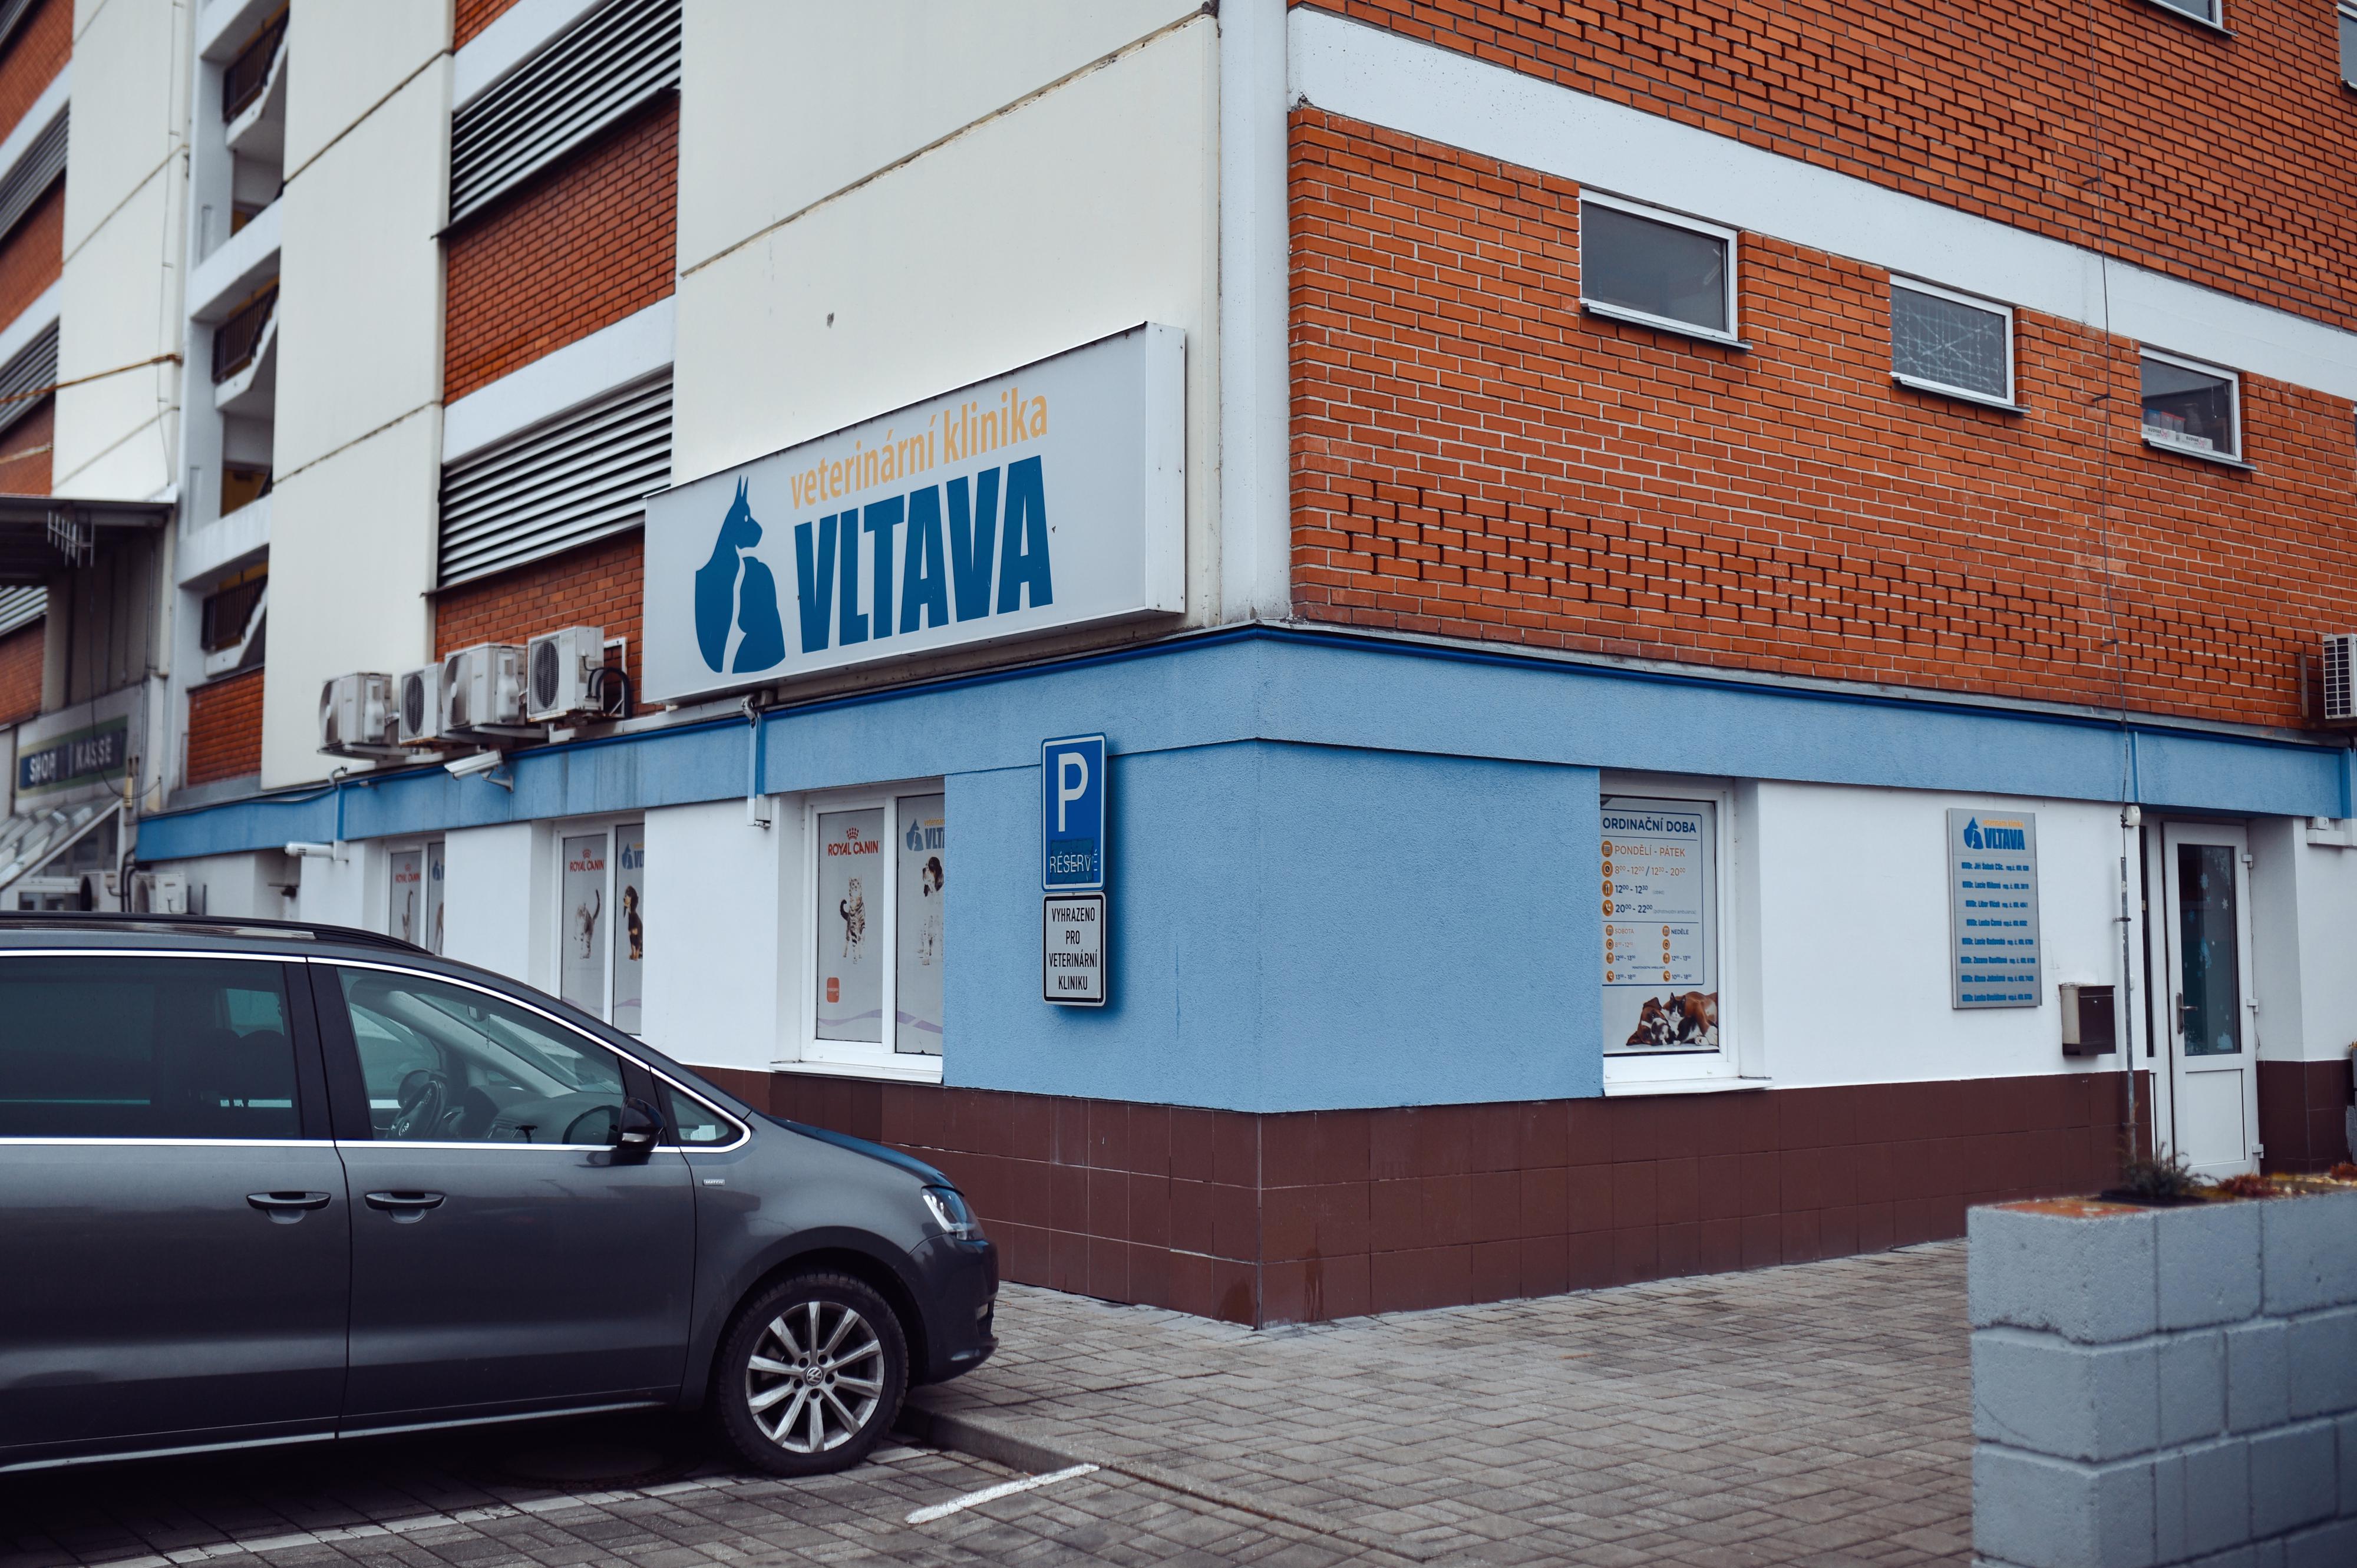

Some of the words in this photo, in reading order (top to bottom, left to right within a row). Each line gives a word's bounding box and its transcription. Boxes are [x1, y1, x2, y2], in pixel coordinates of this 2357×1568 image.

[790, 415, 935, 510] veterinární
[943, 387, 1048, 464] klinika
[794, 455, 1054, 654] VLTAVA
[75, 735, 112, 770] KASSE
[1058, 752, 1088, 832] P
[1603, 817, 1663, 831] ORDINAČNÍ
[1667, 821, 1696, 833] DOBA
[925, 827, 945, 849] VLT
[1984, 828, 2025, 850] VLTAVA
[828, 843, 851, 856] ROYAL
[853, 840, 878, 854] CANIN
[1615, 844, 1652, 856] PONDĚLÍ
[1660, 846, 1685, 857] PÁTEK
[570, 861, 586, 872] ROYAL
[587, 859, 604, 870] CANIN
[1052, 907, 1095, 922] VYHRAZENO
[1066, 930, 1080, 944] PRO
[1049, 949, 1097, 967] VETERINÁRNÍ
[1059, 976, 1088, 990] KLINIKU
